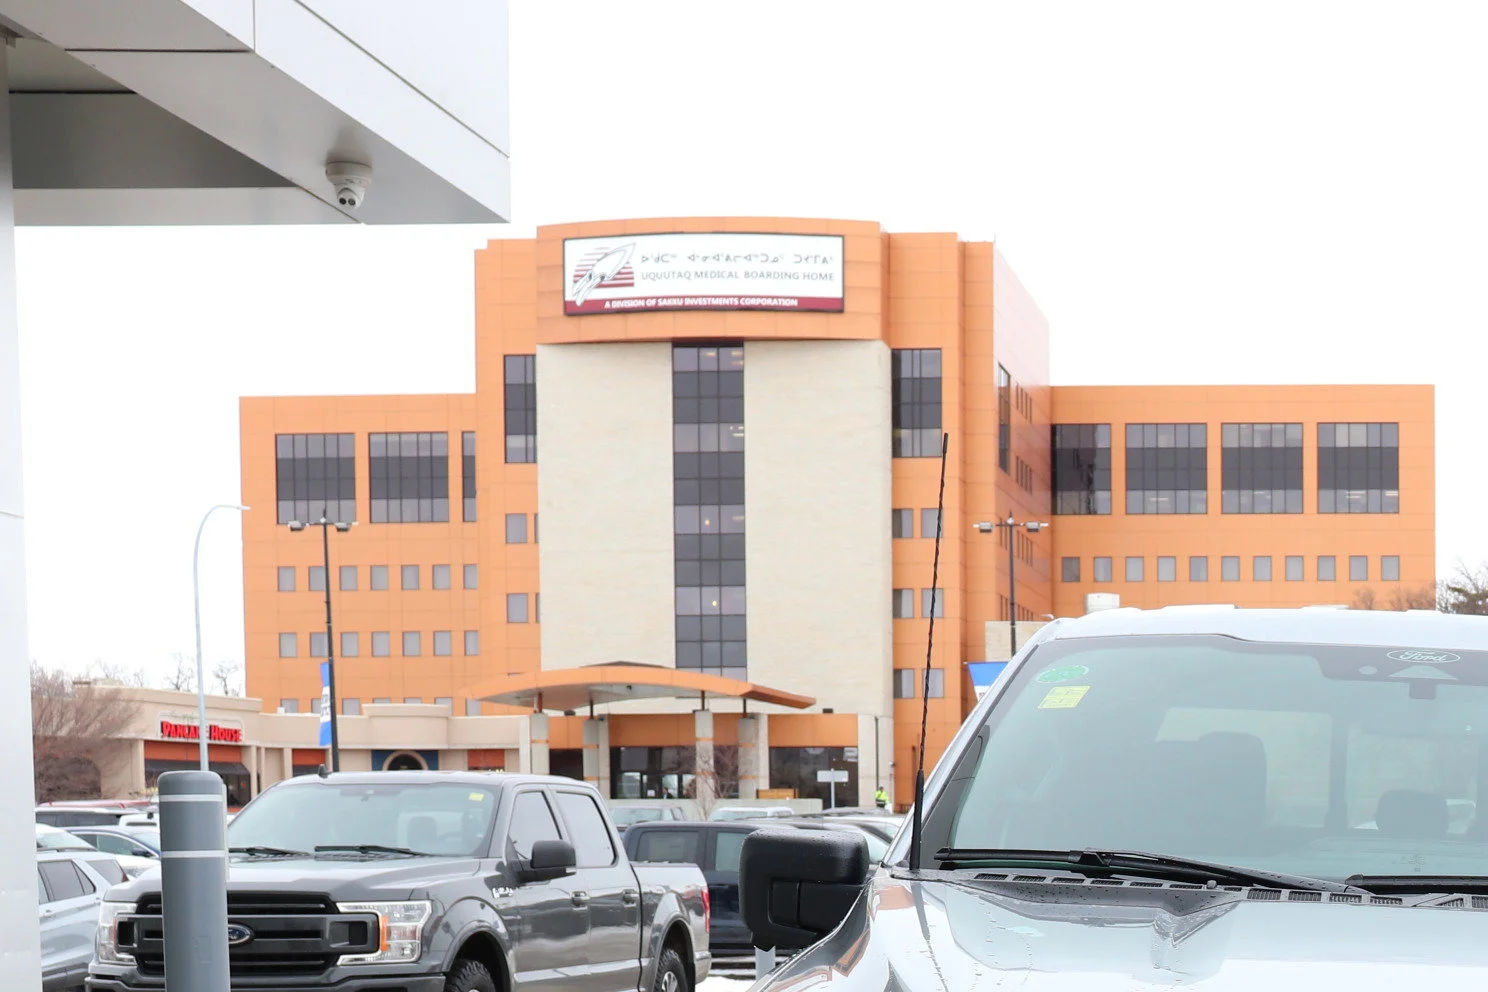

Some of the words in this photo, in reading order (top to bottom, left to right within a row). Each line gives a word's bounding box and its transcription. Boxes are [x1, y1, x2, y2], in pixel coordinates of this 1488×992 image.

[641, 270, 691, 282] UQUUTAQ
[694, 270, 739, 280] MEDICAL
[743, 270, 800, 280] BOARDING
[802, 271, 835, 281] HOME
[612, 300, 645, 308] DIVISION
[646, 299, 657, 307] OF
[684, 297, 738, 306] INVESTMENTS
[739, 297, 798, 306] CORPORATION
[1399, 650, 1447, 661] Ford
[209, 724, 242, 742] HOUSE
